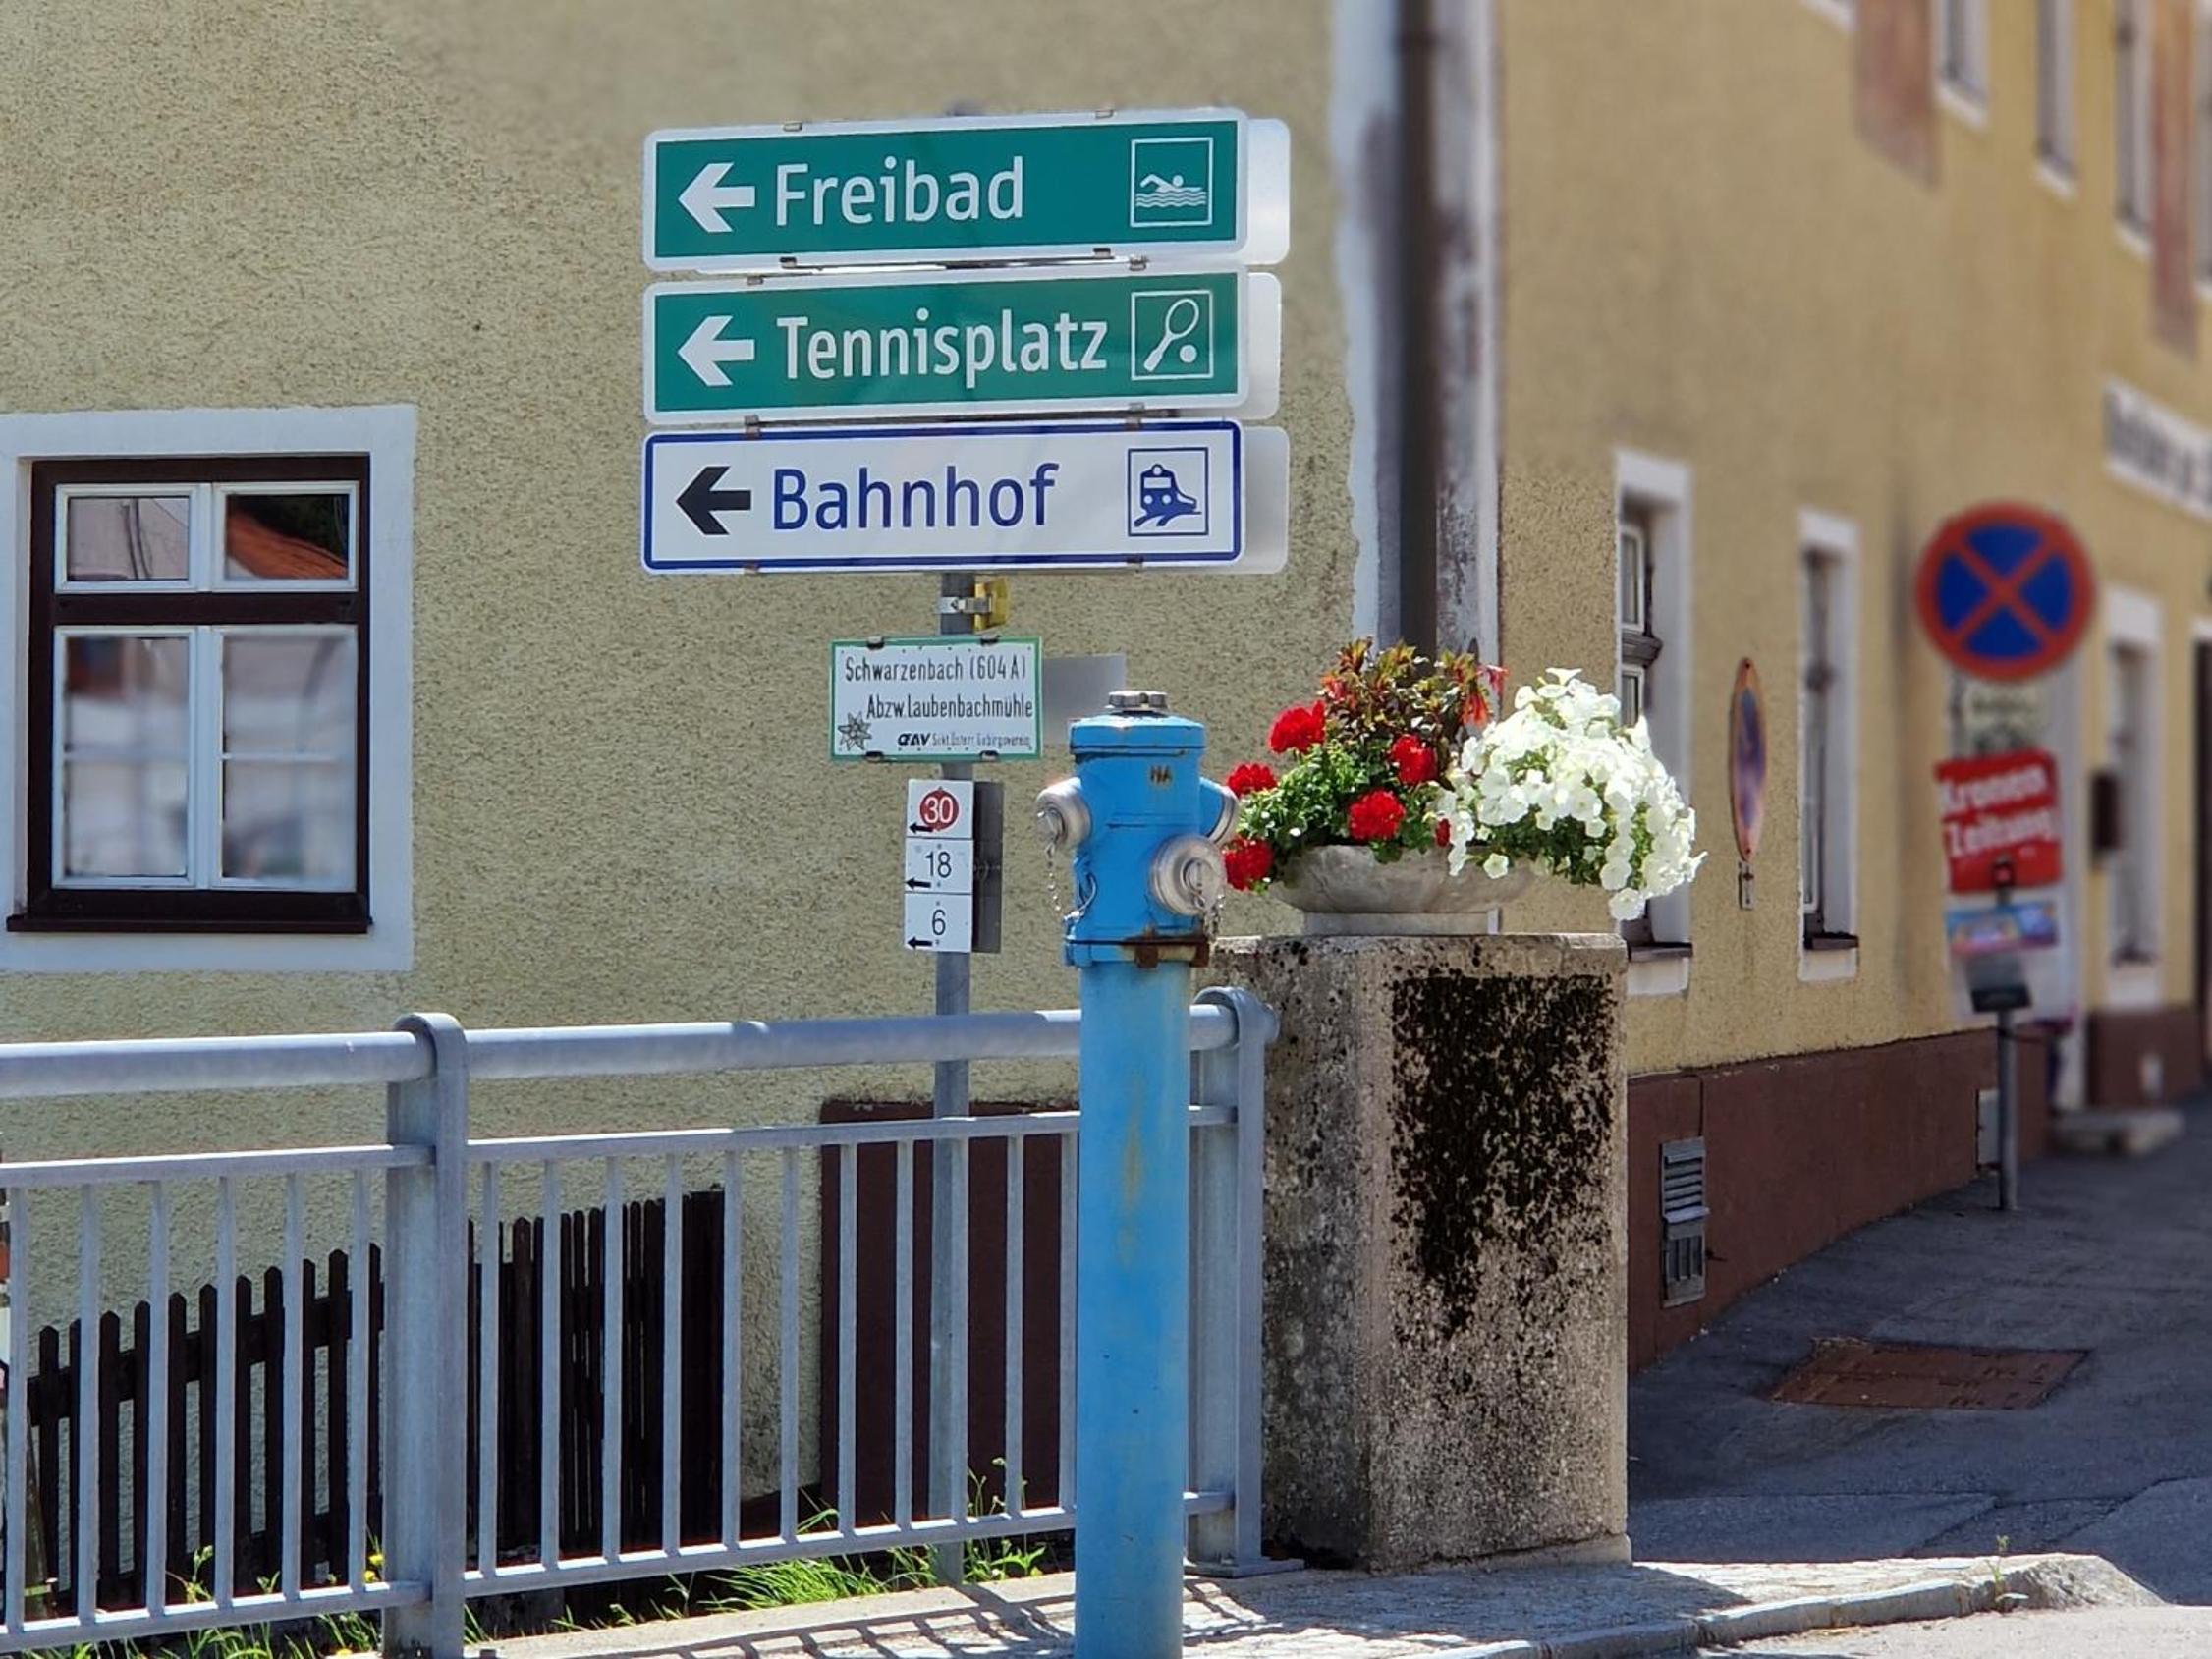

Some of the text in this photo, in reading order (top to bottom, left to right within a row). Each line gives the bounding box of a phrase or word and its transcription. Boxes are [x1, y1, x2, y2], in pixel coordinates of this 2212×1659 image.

[775, 155, 1024, 227] Freibad
[776, 307, 1109, 390] Tennisplatz
[773, 462, 1060, 531] Bahnhof
[845, 655, 964, 683] Schwarzenbach
[924, 796, 954, 824] 30
[924, 851, 952, 879] 18
[931, 909, 946, 936] 6
